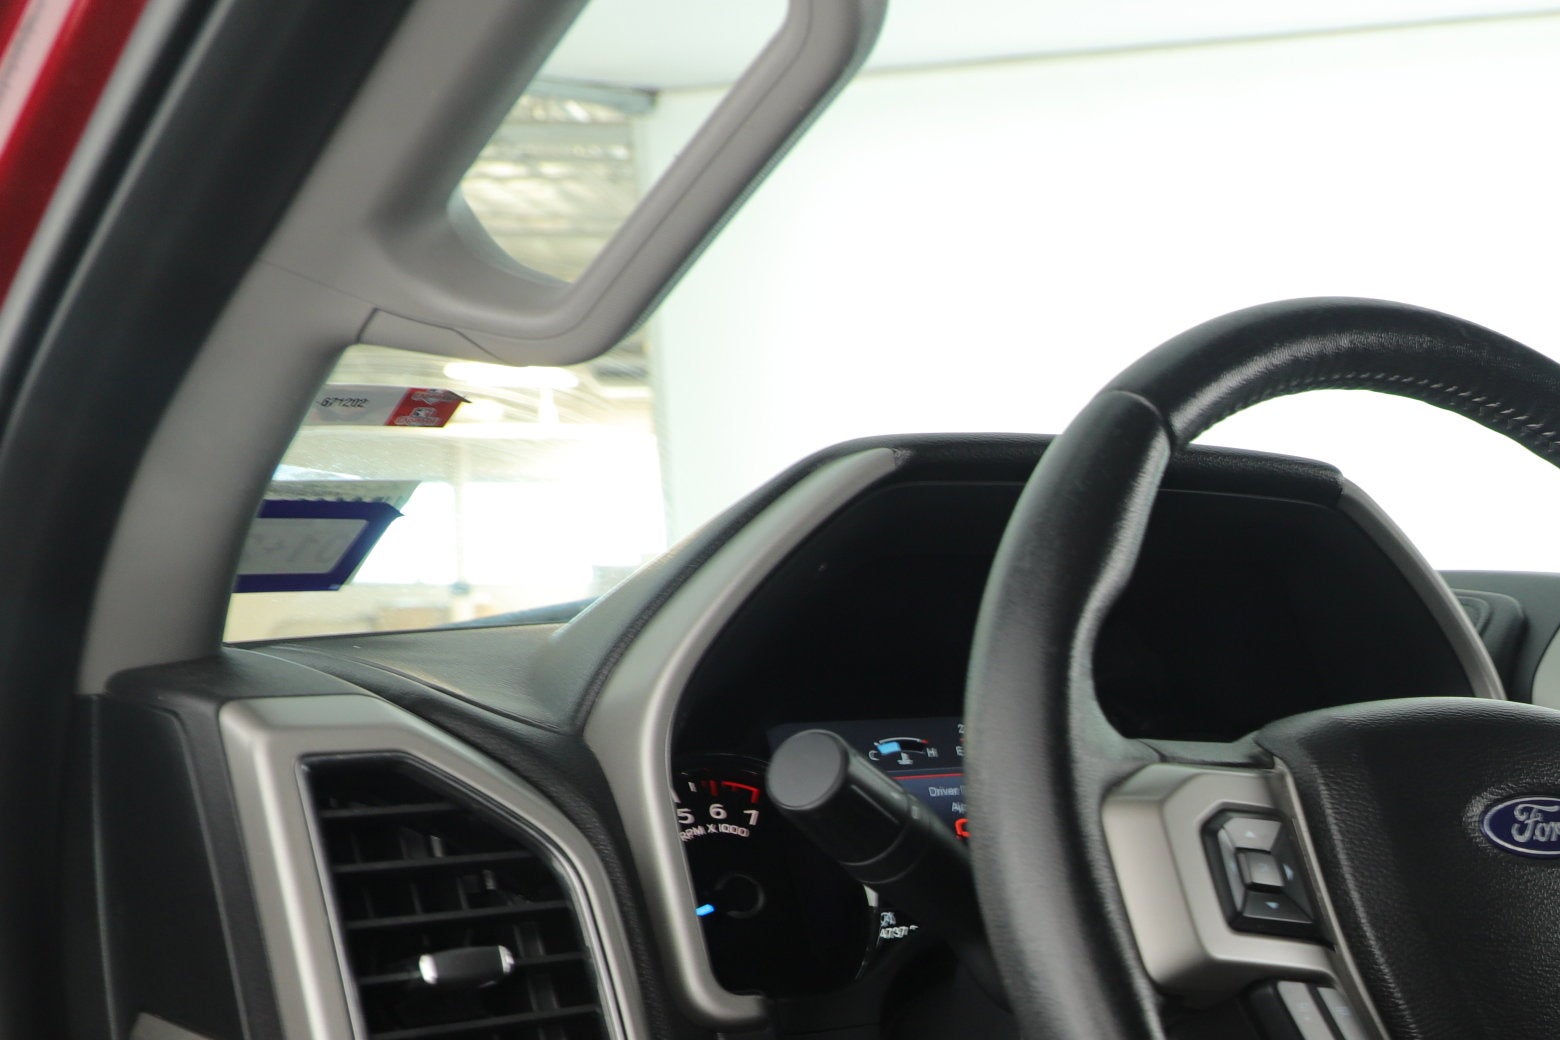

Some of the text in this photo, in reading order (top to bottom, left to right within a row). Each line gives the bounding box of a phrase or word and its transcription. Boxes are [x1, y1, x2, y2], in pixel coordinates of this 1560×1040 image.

[928, 785, 959, 798] Driver
[676, 807, 696, 825] 5
[709, 803, 728, 820] 6
[743, 809, 760, 826] 7
[680, 824, 707, 842] RPM
[719, 823, 750, 838] 1000
